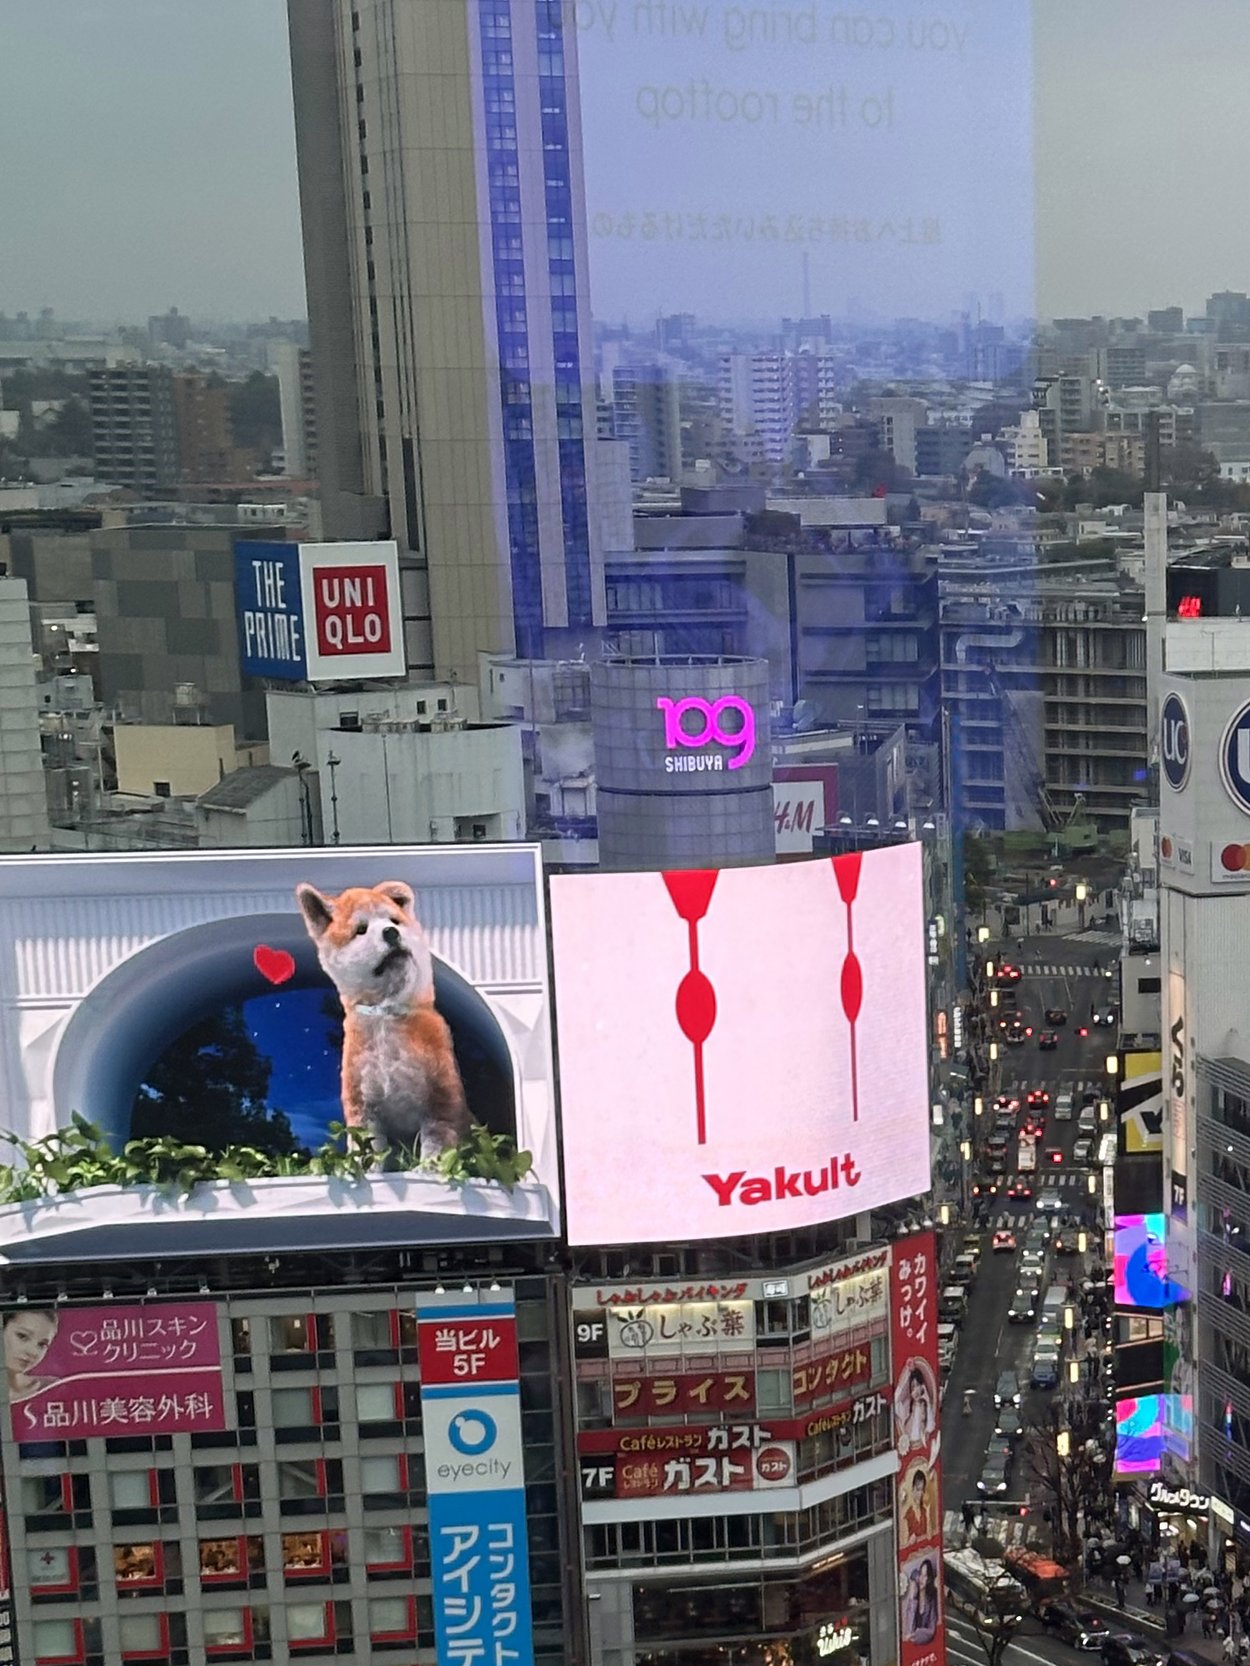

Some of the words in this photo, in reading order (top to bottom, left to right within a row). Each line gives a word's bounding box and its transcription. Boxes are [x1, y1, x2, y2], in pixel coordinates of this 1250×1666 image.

[251, 560, 288, 610] THE
[322, 577, 376, 608] UNI
[244, 611, 301, 662] PRIME
[325, 614, 383, 651] QLO
[657, 695, 755, 769] 109
[1164, 717, 1188, 765] UC
[664, 755, 723, 773] SHIBUYA
[701, 1153, 861, 1206] Yakult
[913, 1252, 928, 1345] カワイイ
[100, 1314, 208, 1341] 品川スキン
[576, 1323, 604, 1343] 9F
[659, 1309, 744, 1340] しゃぶ葉
[103, 1340, 198, 1364] クリニック
[435, 1328, 500, 1352] 当ビル
[453, 1353, 486, 1377] 5F
[793, 1350, 868, 1396] コンタクト
[614, 1376, 749, 1409] プライス
[43, 1394, 213, 1429] 品川美容外科
[852, 1396, 887, 1424] ガスト
[708, 1425, 772, 1453] ガスト
[437, 1458, 511, 1482] eyecity
[581, 1467, 615, 1489] 7F
[622, 1464, 659, 1480] Café
[663, 1457, 746, 1492] ガスト
[760, 1460, 788, 1472] ガスト
[1150, 1482, 1209, 1510] グルメタウン
